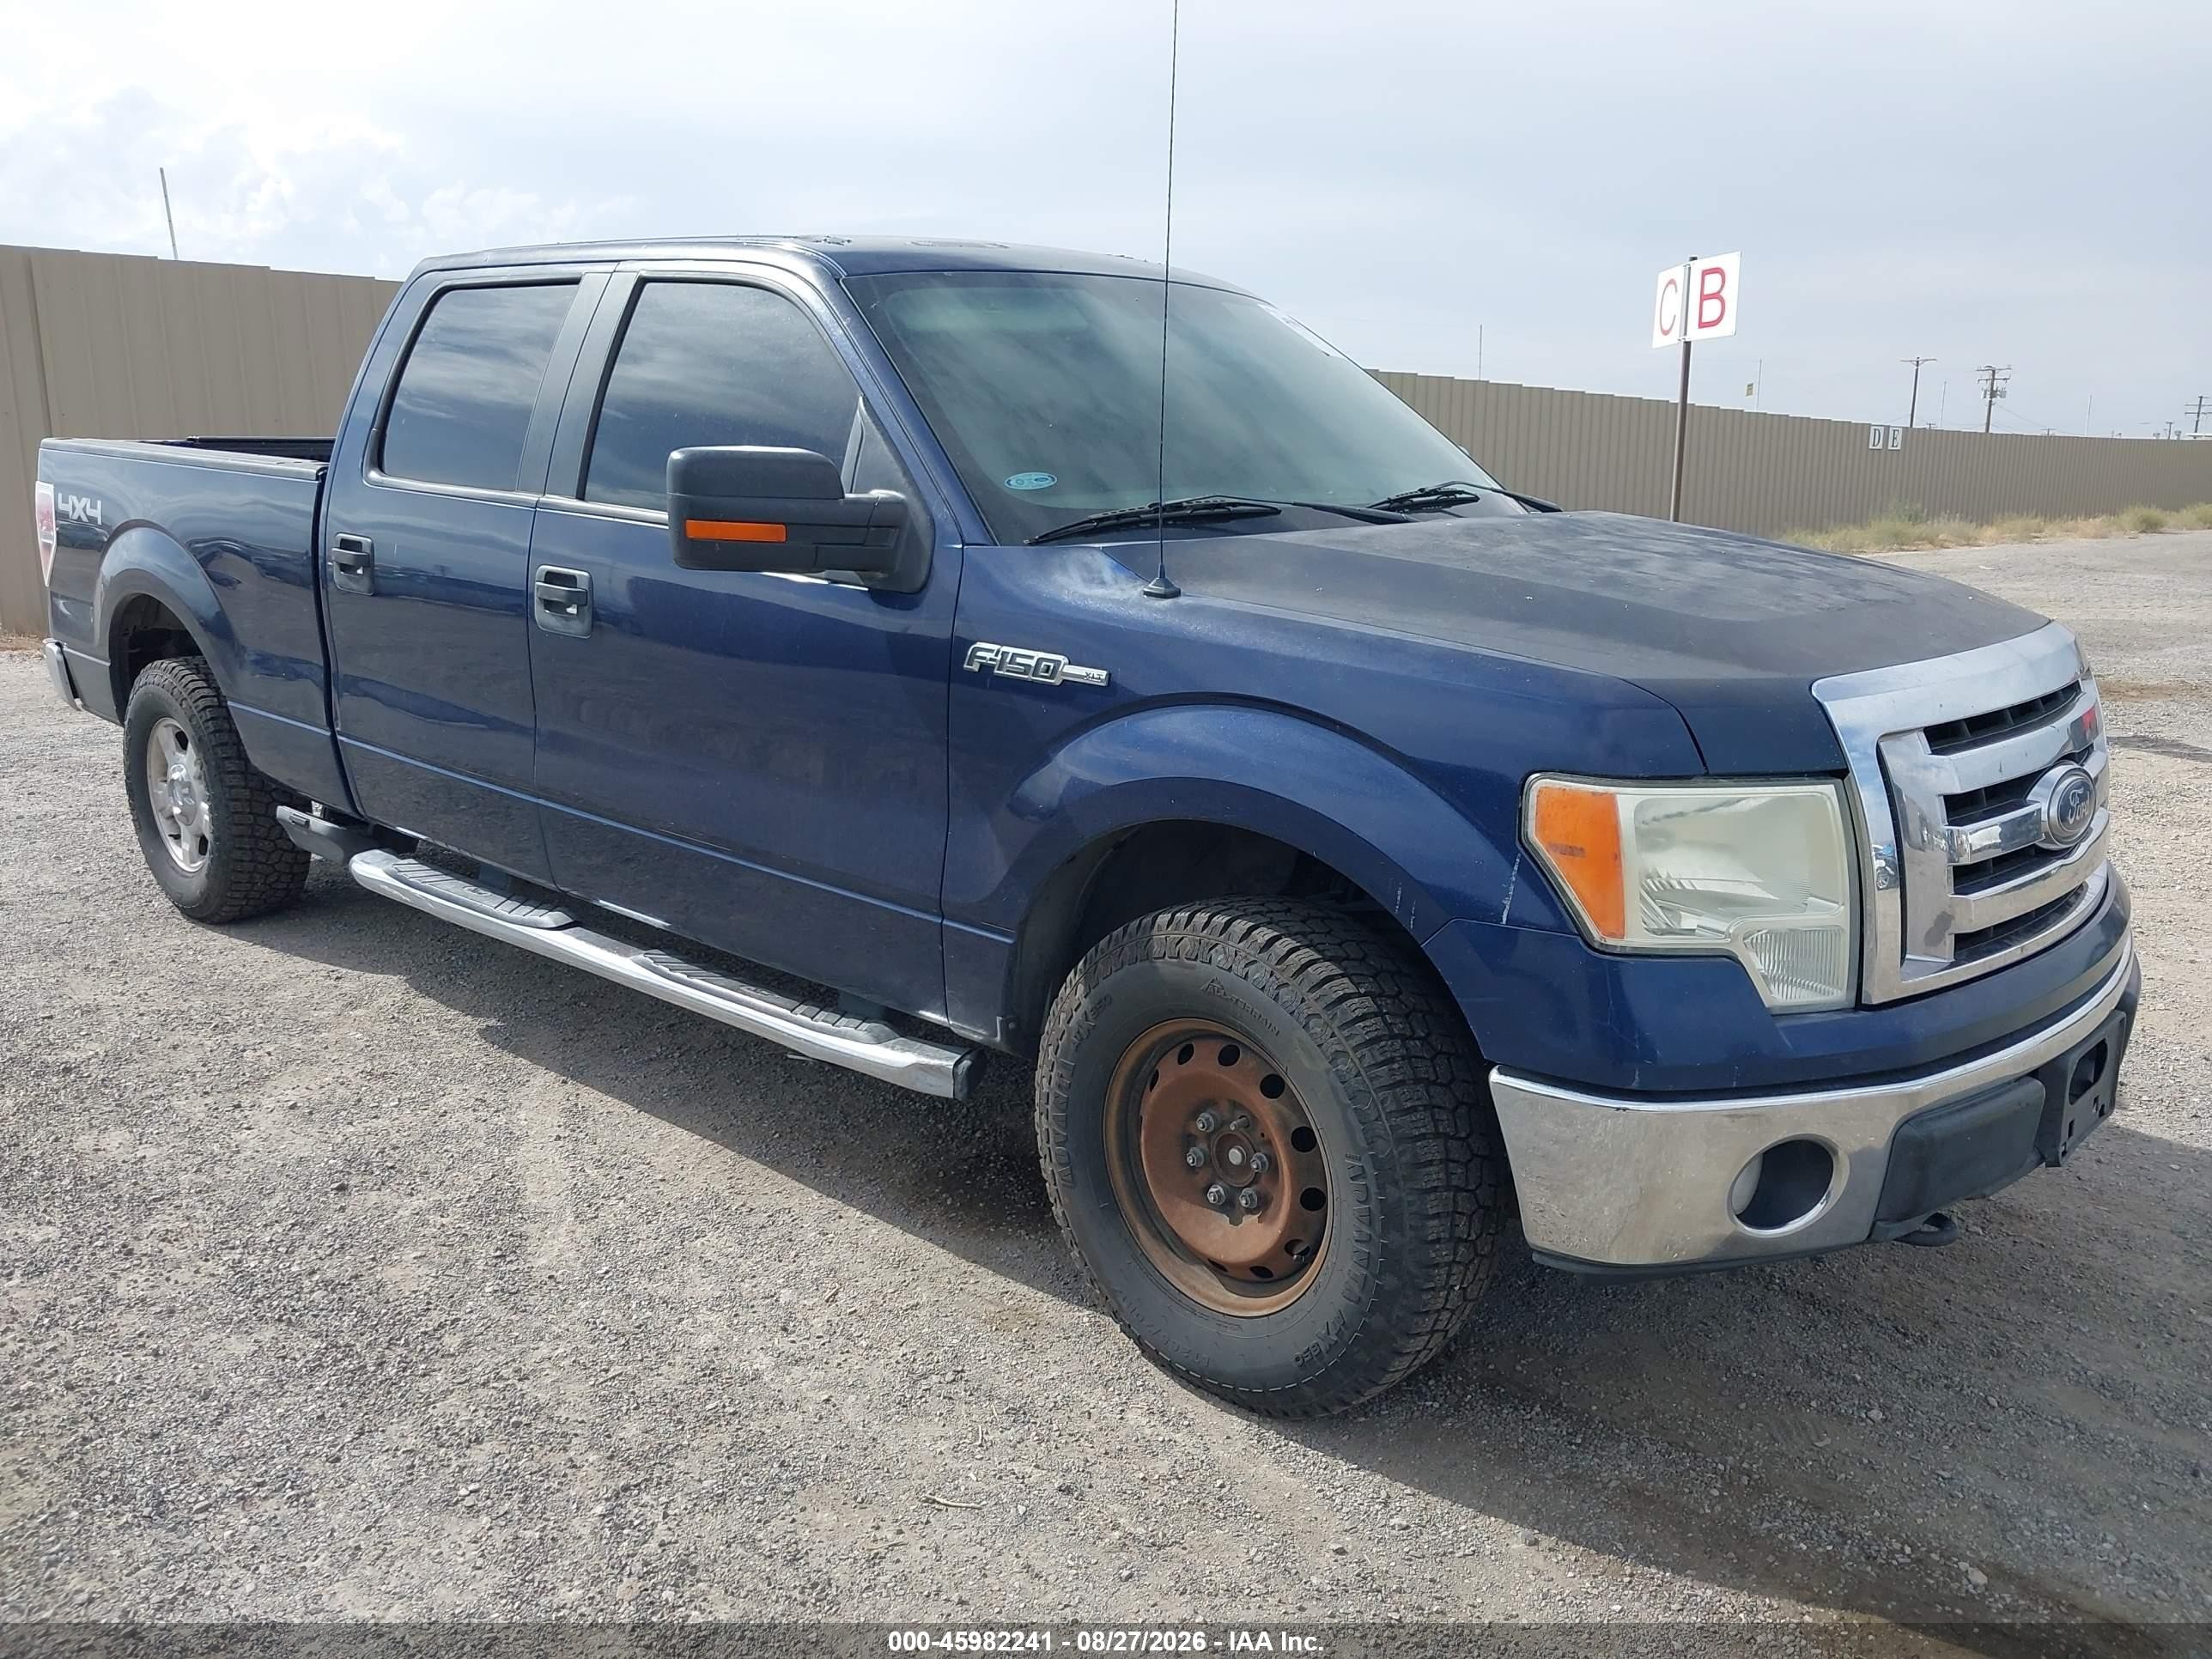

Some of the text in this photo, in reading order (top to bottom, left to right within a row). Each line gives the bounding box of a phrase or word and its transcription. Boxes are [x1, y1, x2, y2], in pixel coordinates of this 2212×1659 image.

[1659, 278, 1678, 336] C
[1697, 266, 1726, 329] B
[1872, 428, 1881, 447] D
[1891, 428, 1899, 447] E
[58, 493, 102, 526] 4X4
[1084, 671, 1103, 682] XLT
[2068, 787, 2090, 825] Ford
